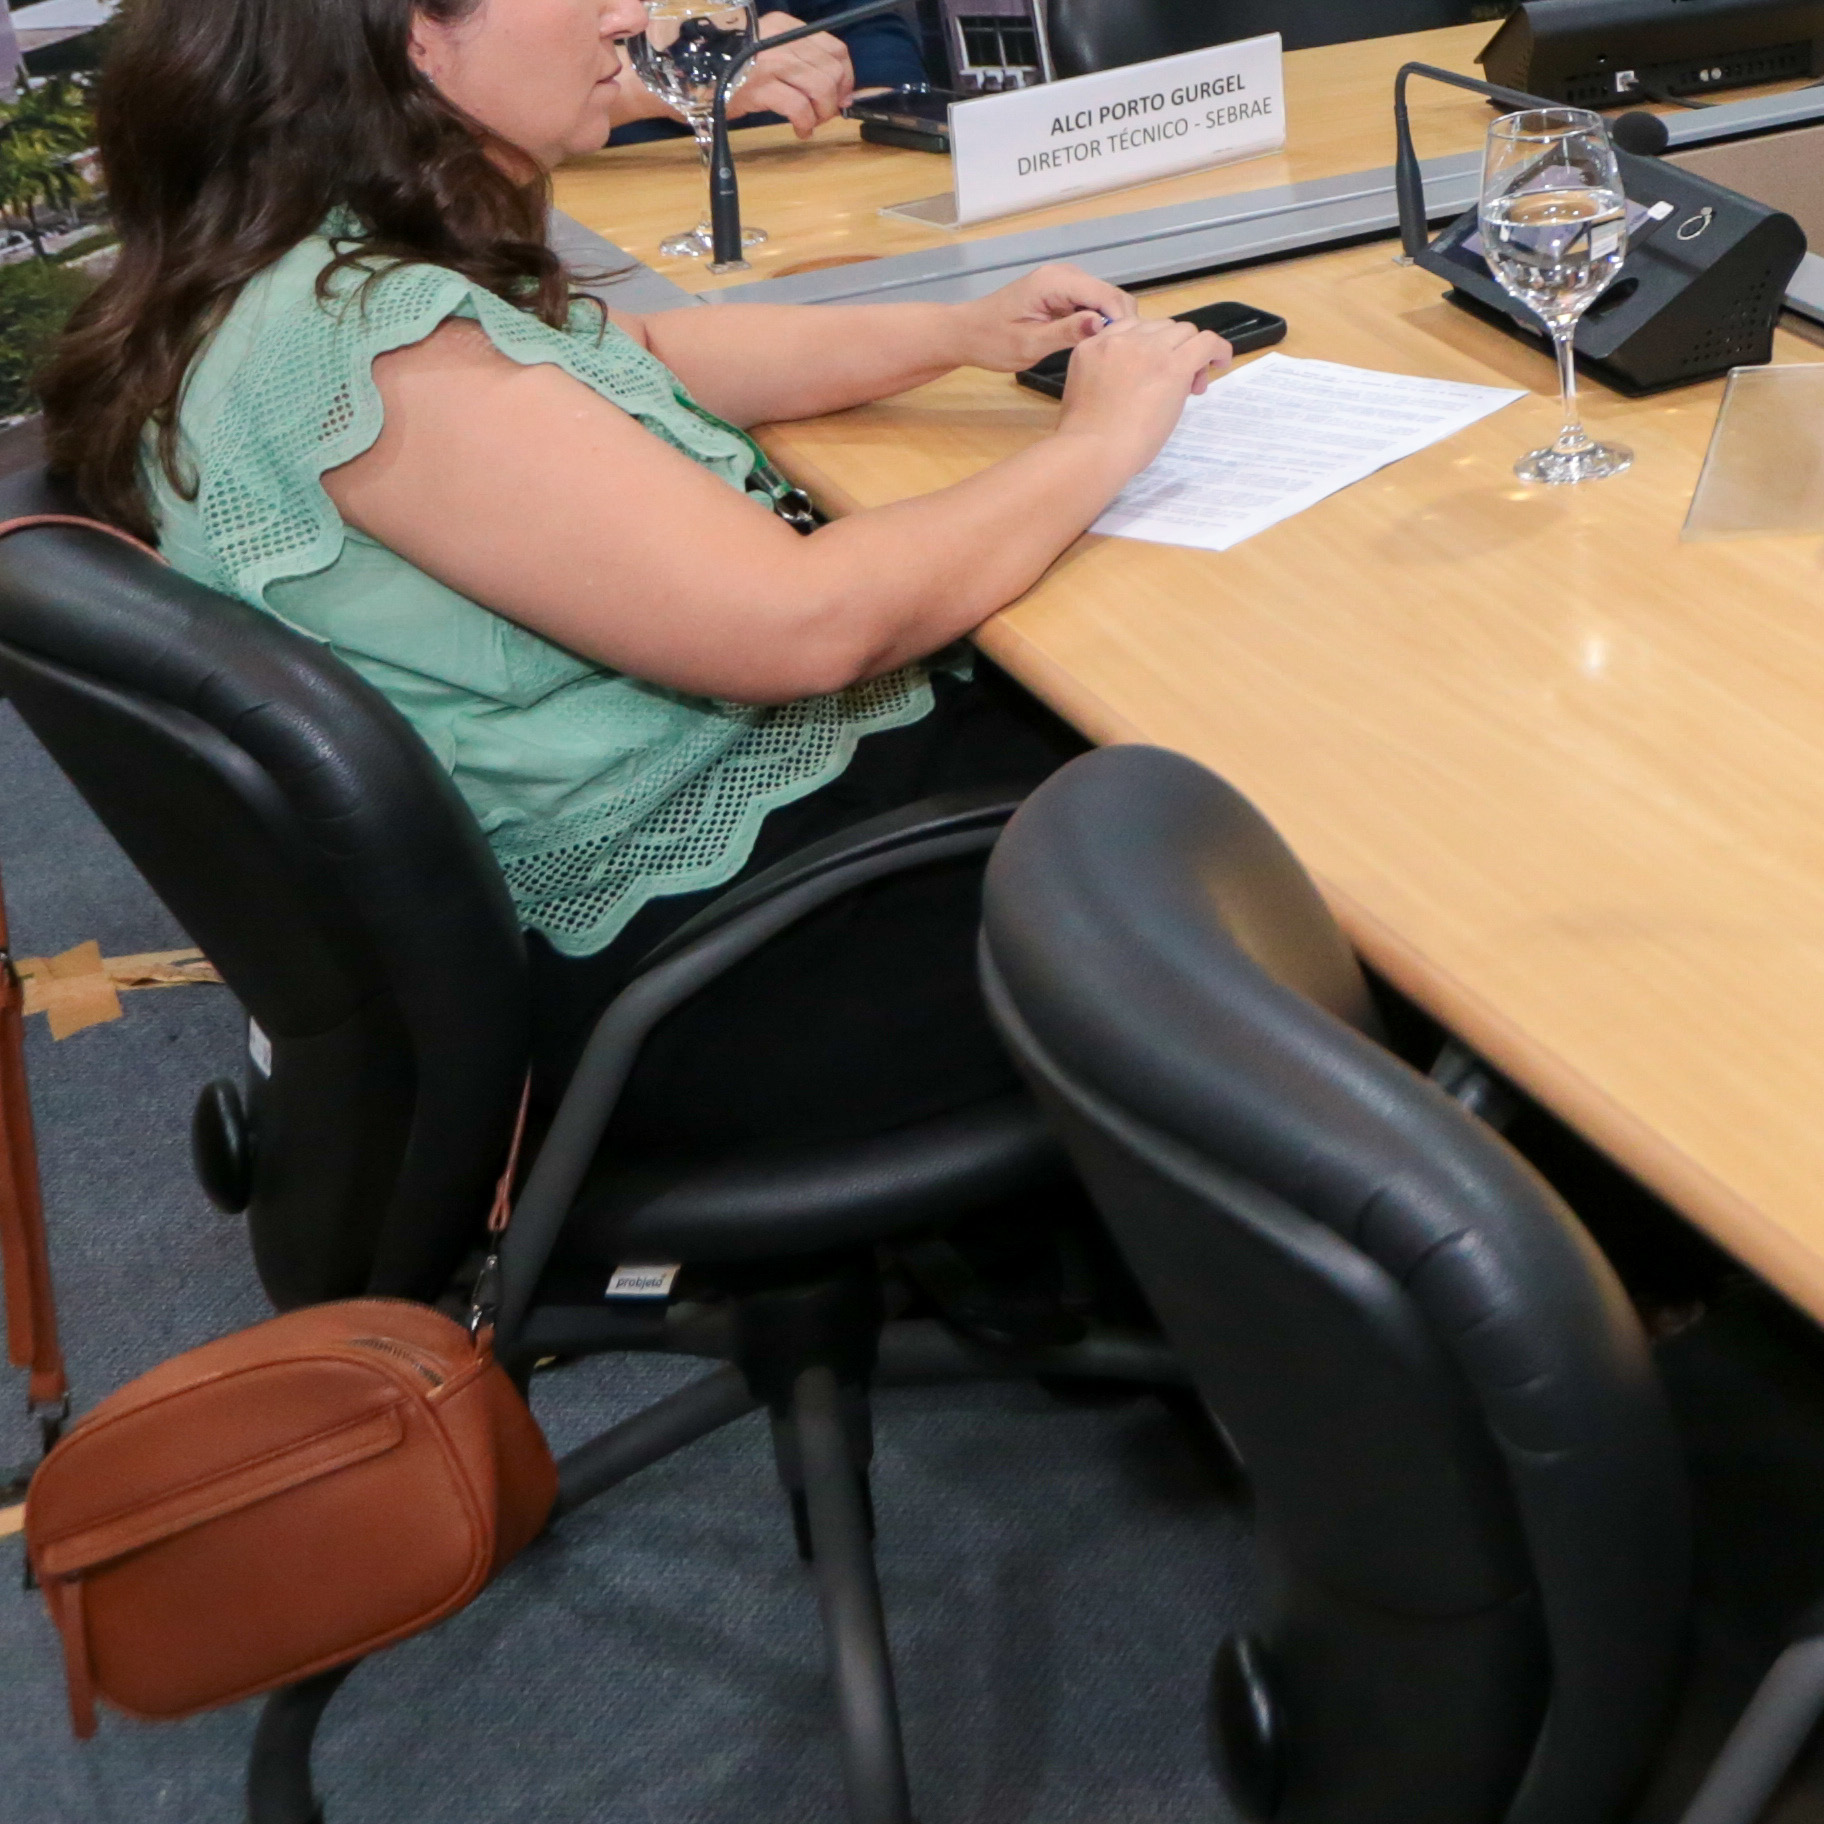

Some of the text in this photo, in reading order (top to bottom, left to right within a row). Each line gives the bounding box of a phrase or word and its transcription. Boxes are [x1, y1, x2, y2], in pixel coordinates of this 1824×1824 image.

[1018, 139, 1102, 176] DIRETOR
[1107, 118, 1188, 153] TÉCNICO
[1205, 96, 1273, 129] SEBRAE
[1051, 74, 1246, 136] ALCI PORTO GURGEL
[615, 1276, 663, 1289] probjeto
